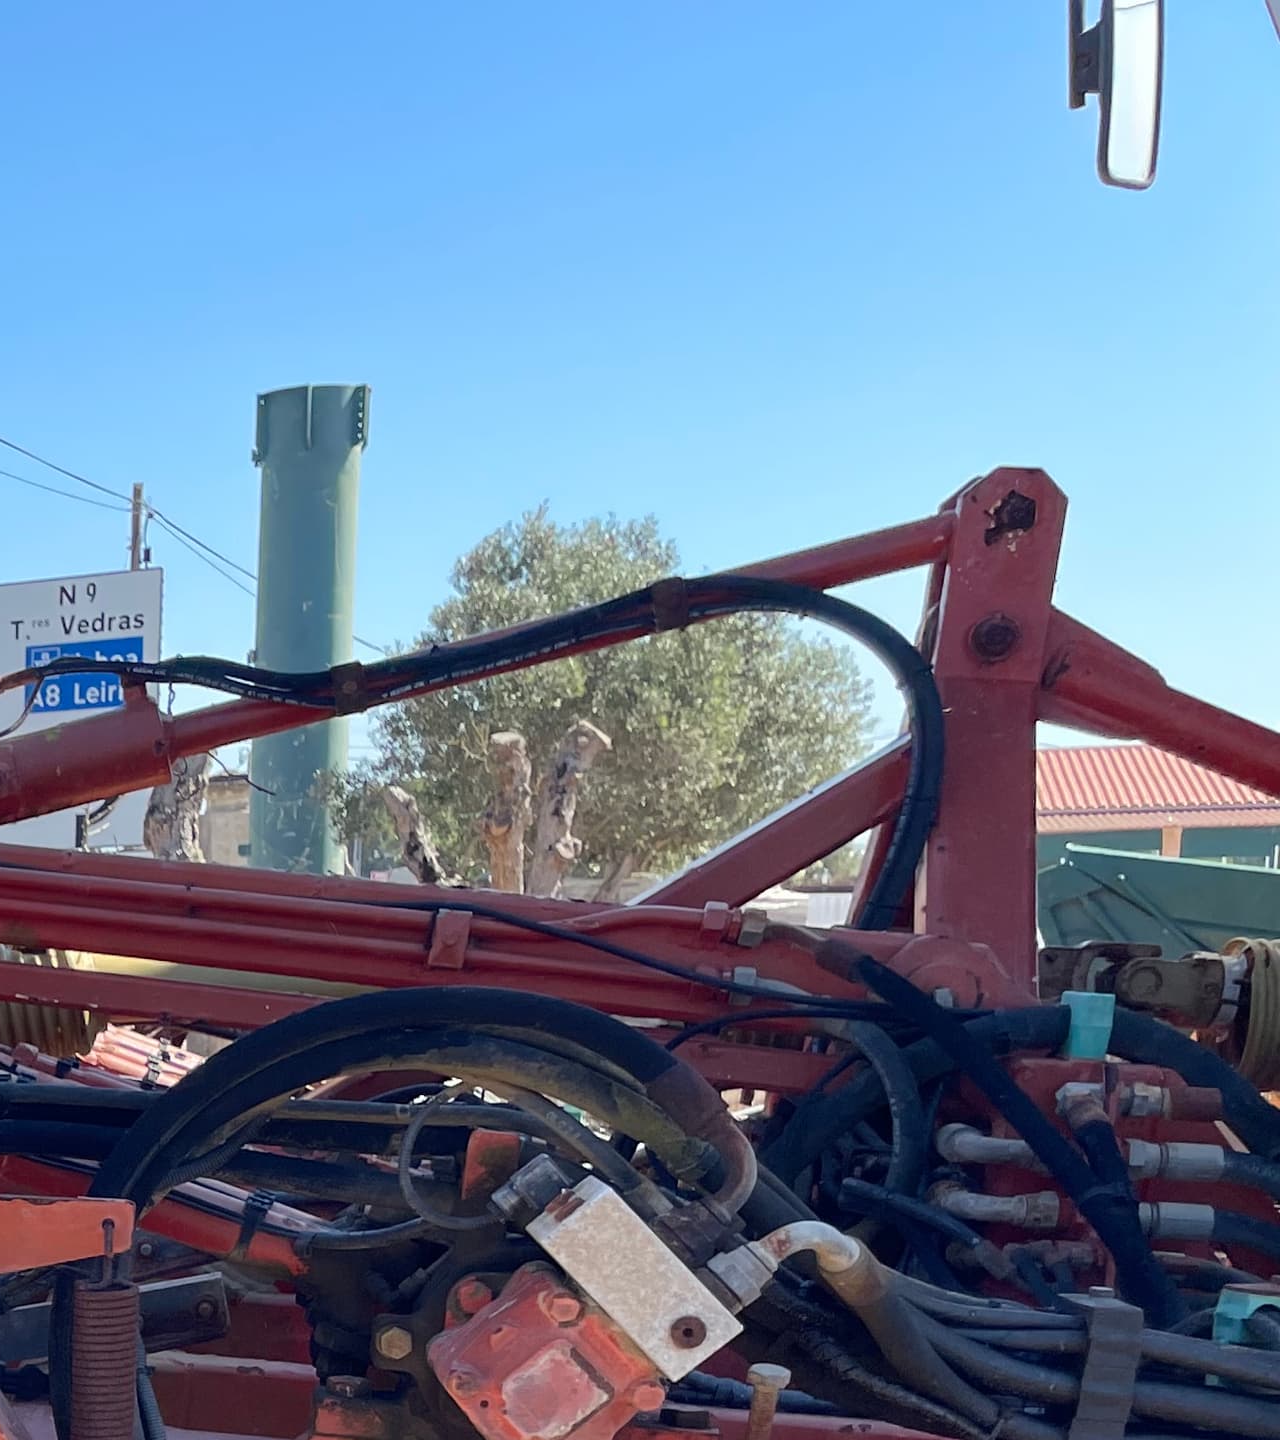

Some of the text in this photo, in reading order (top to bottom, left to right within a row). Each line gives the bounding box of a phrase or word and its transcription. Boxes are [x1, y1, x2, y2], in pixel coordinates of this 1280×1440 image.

[59, 582, 96, 606] N 9
[61, 611, 145, 636] Vedras
